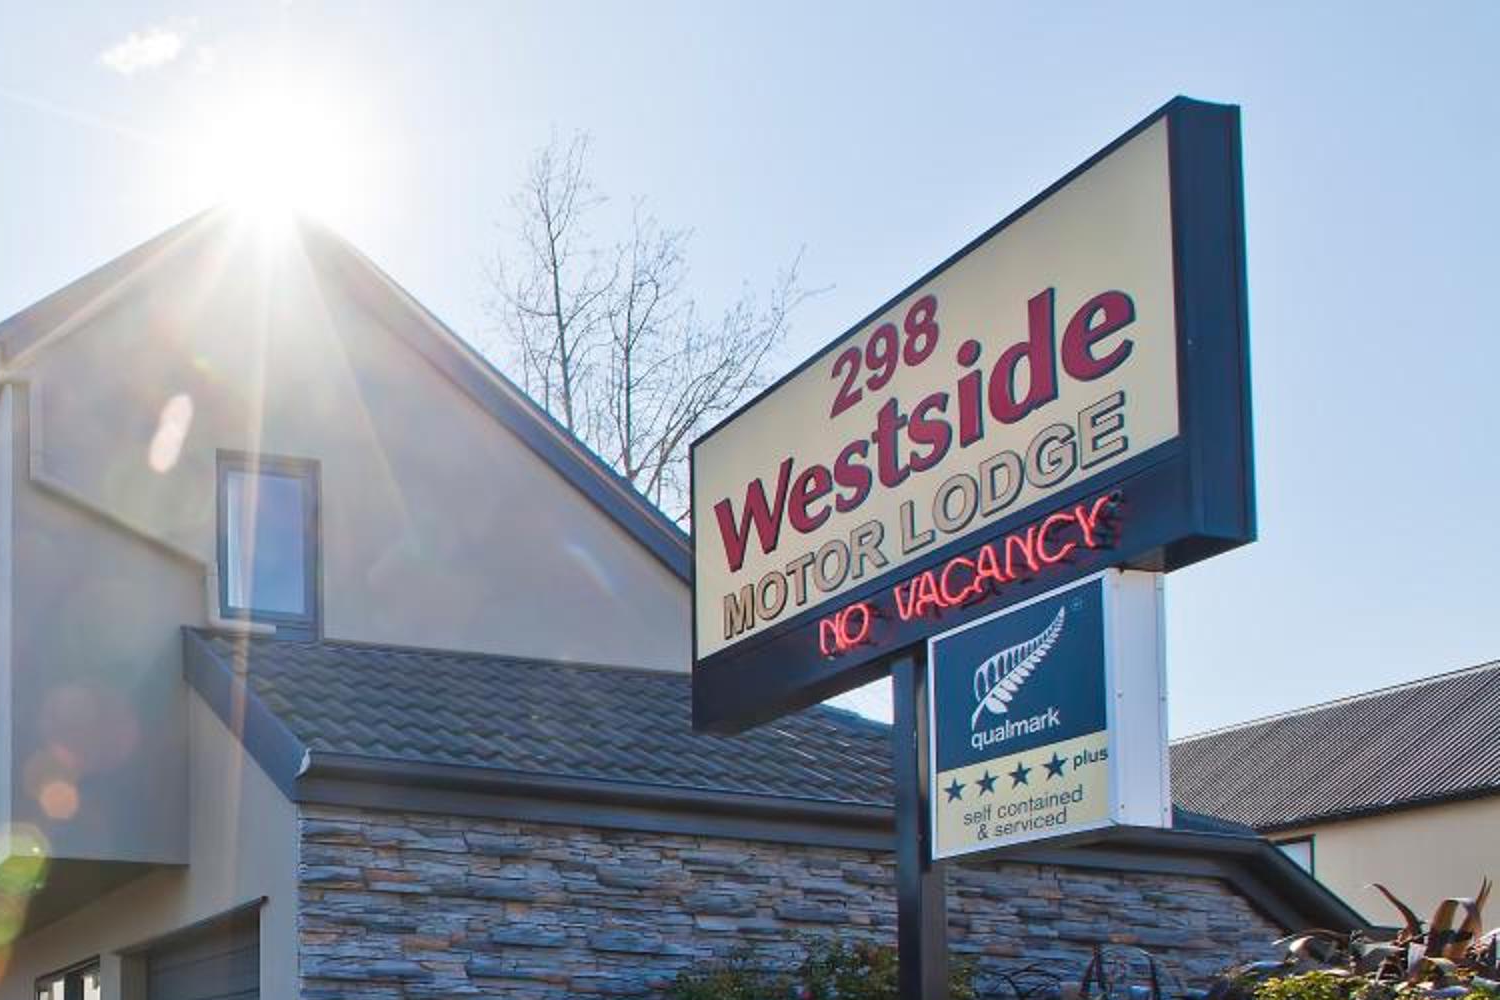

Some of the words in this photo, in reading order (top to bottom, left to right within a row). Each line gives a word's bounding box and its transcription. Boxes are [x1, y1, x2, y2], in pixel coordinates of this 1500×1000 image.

[830, 294, 939, 419] 298
[714, 287, 1137, 573] Westside
[724, 520, 889, 640] MOTOR
[900, 390, 1129, 556] LODGE
[820, 603, 871, 657] NO
[895, 495, 1115, 620] VACANCY
[971, 706, 1061, 750] qualmark
[1073, 747, 1108, 770] plus
[963, 805, 992, 826] self
[997, 784, 1084, 819] contained
[977, 823, 989, 841] &
[995, 807, 1068, 838] serviced
